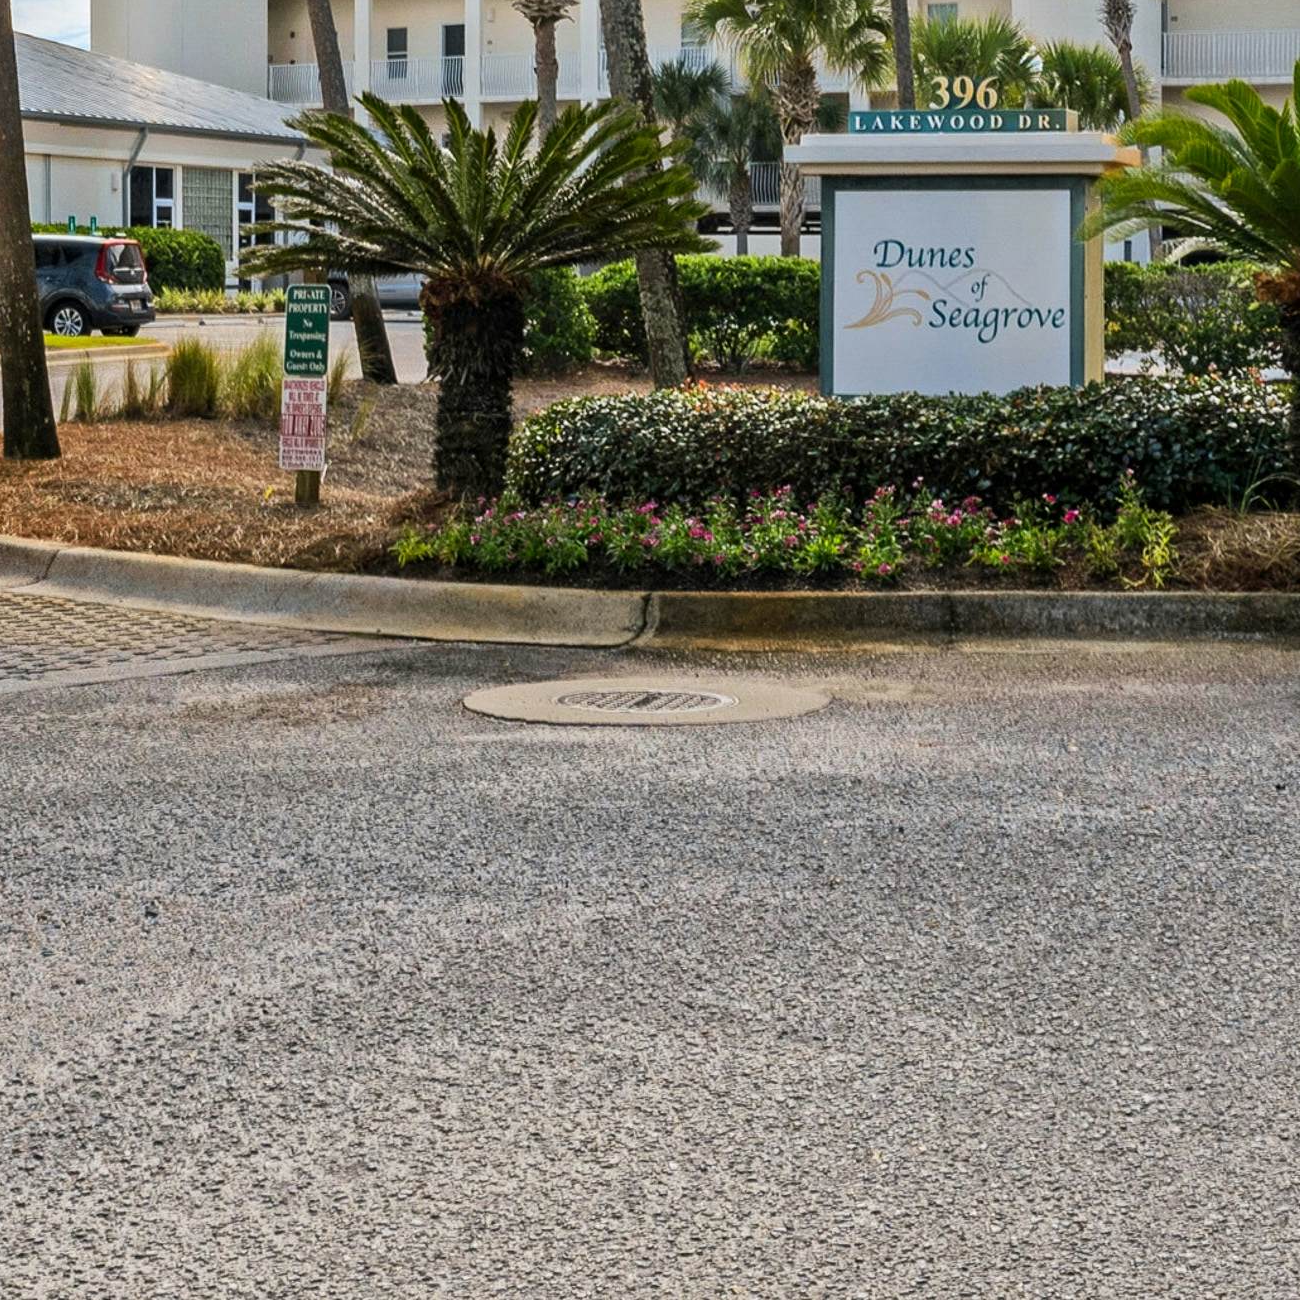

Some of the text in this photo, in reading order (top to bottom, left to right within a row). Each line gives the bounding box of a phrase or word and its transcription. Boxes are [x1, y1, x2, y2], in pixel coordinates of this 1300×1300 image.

[928, 75, 1000, 110] 396
[854, 114, 1061, 131] LAKEWOOD DR.
[873, 238, 975, 269] Dunes
[293, 289, 326, 300] PRIVATE
[970, 272, 991, 303] of
[288, 303, 328, 314] PROPERTY
[302, 318, 314, 328] No
[928, 298, 1066, 344] Seagrove
[289, 349, 323, 360] Owners &
[309, 362, 326, 372] Only
